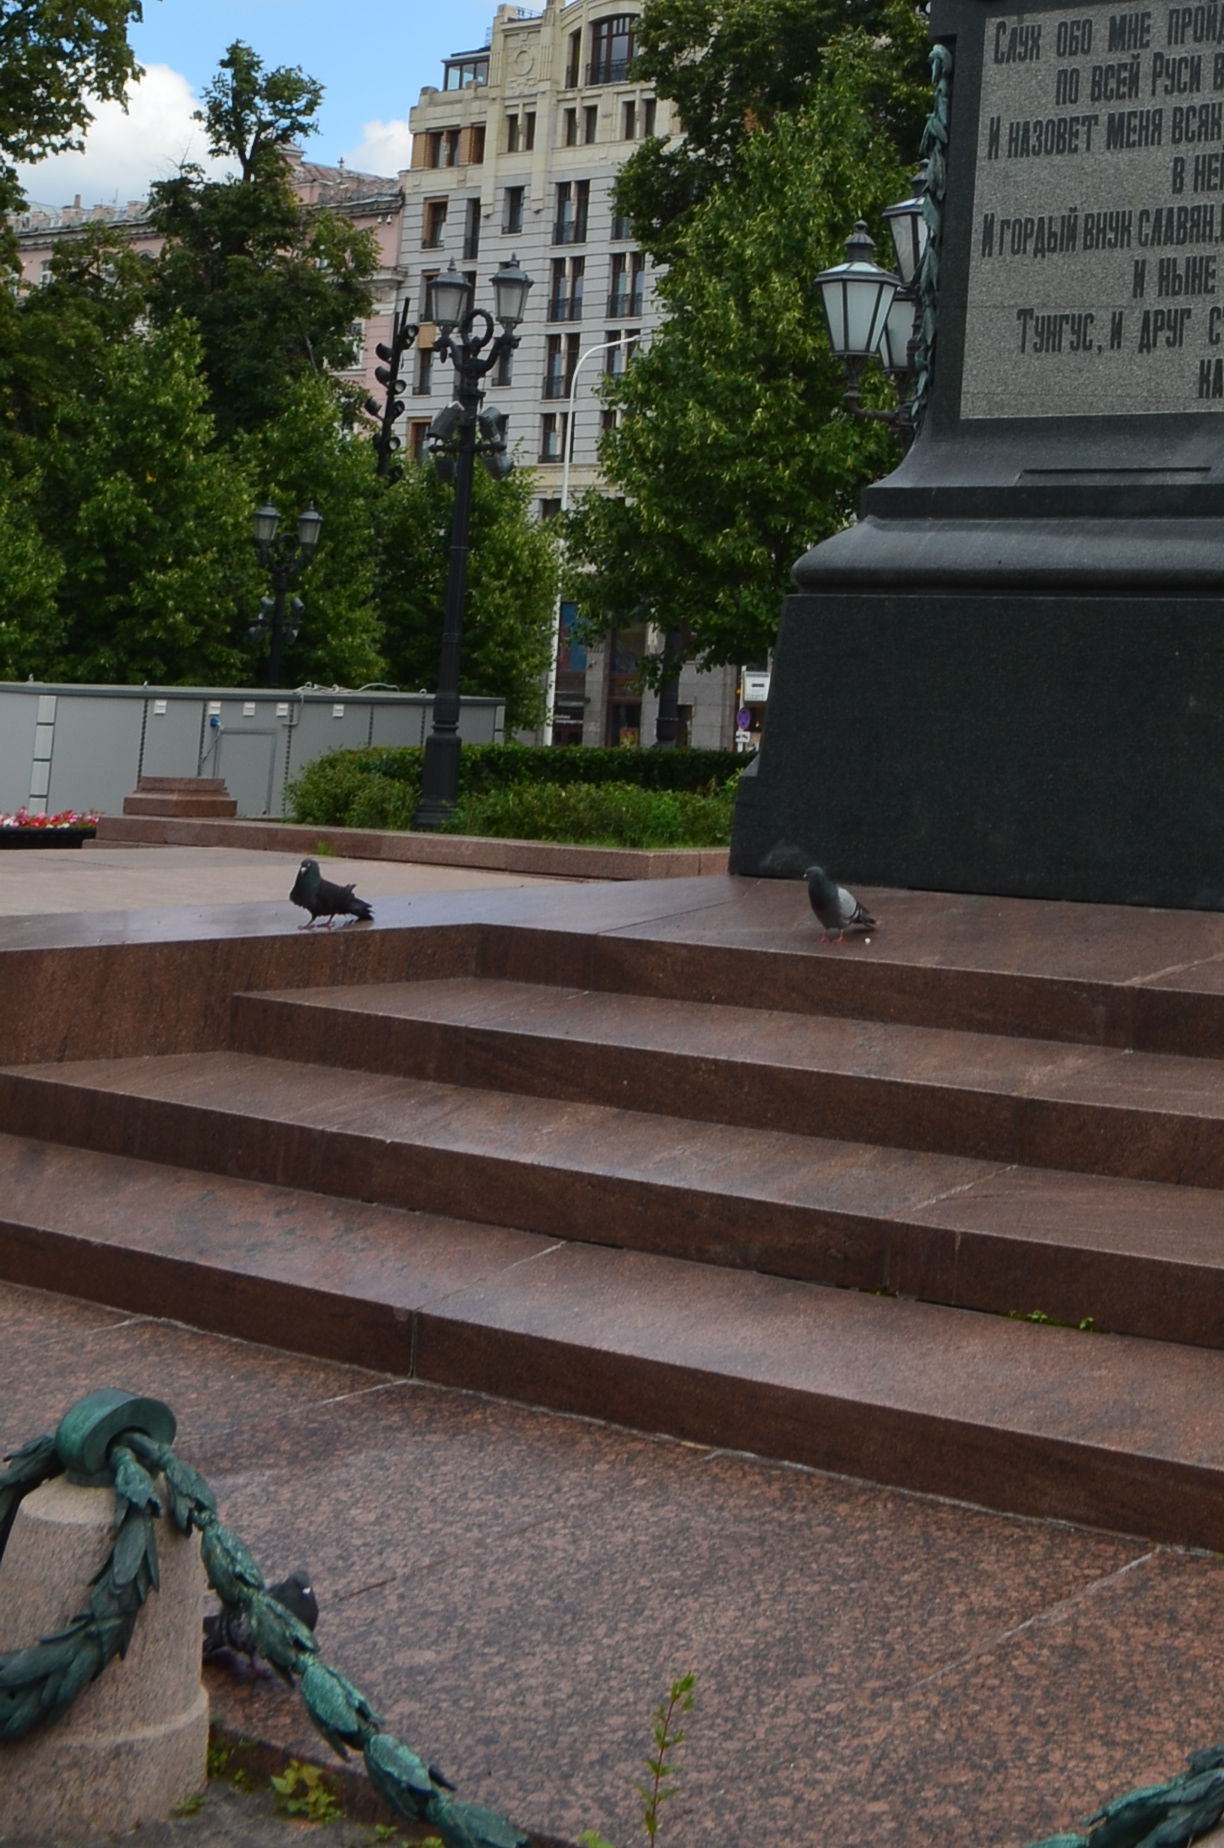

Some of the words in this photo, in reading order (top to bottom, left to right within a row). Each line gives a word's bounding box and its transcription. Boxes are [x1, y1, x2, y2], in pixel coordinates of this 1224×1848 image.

[994, 20, 1042, 64] СЛУХ
[1056, 18, 1093, 57] ОБО
[1108, 11, 1151, 52] МНЕ
[1055, 67, 1080, 105] ПО
[1090, 52, 1141, 103] ВСЕЙ
[1151, 52, 1202, 97] РУСИ
[988, 115, 1001, 160] И
[1007, 114, 1099, 159] НАЗОВЕТ
[1106, 107, 1164, 150] МЕНЯ
[1171, 102, 1223, 145] ВСЯК
[1172, 156, 1186, 195] В
[982, 213, 995, 258] И
[999, 206, 1079, 259] ГОРДЫЙ
[1083, 209, 1133, 250] ВНУК
[1132, 259, 1147, 299] И
[1157, 255, 1217, 298] НЫНЕ
[1016, 308, 1102, 354] ТУНГУС,
[1110, 310, 1124, 350] И
[1138, 307, 1193, 355] ДРУГ
